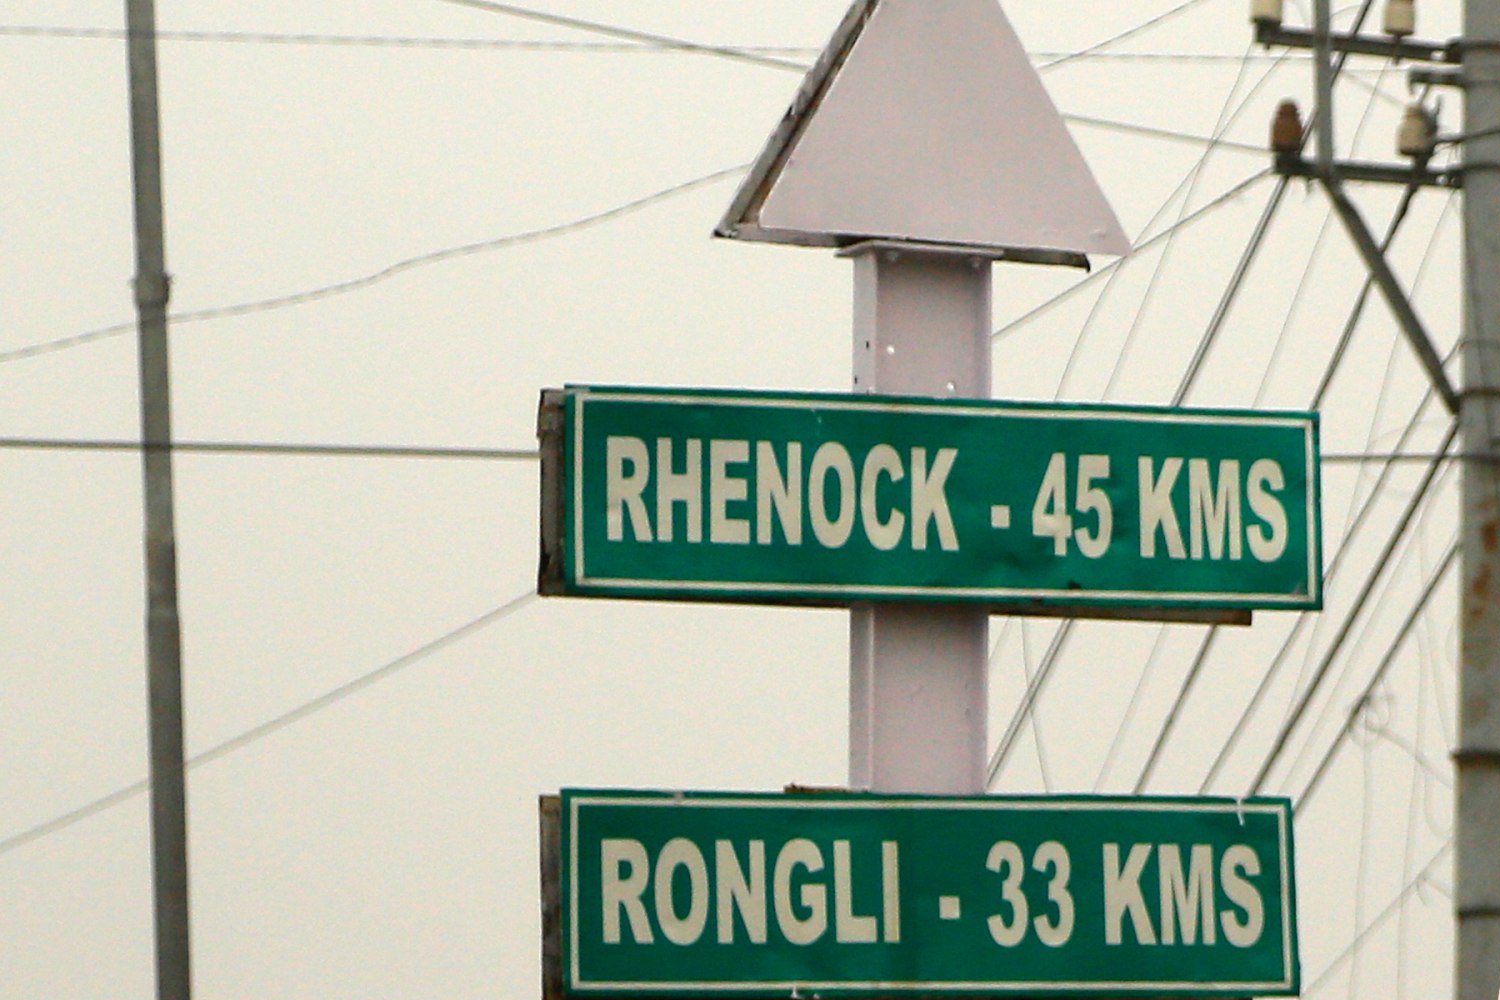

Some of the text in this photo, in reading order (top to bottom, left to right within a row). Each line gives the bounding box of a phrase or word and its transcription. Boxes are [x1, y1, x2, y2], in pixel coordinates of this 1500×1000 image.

[605, 435, 1289, 563] RHENOCK - 45 KMS
[600, 837, 1265, 949] RONGLI - 33 KMS
